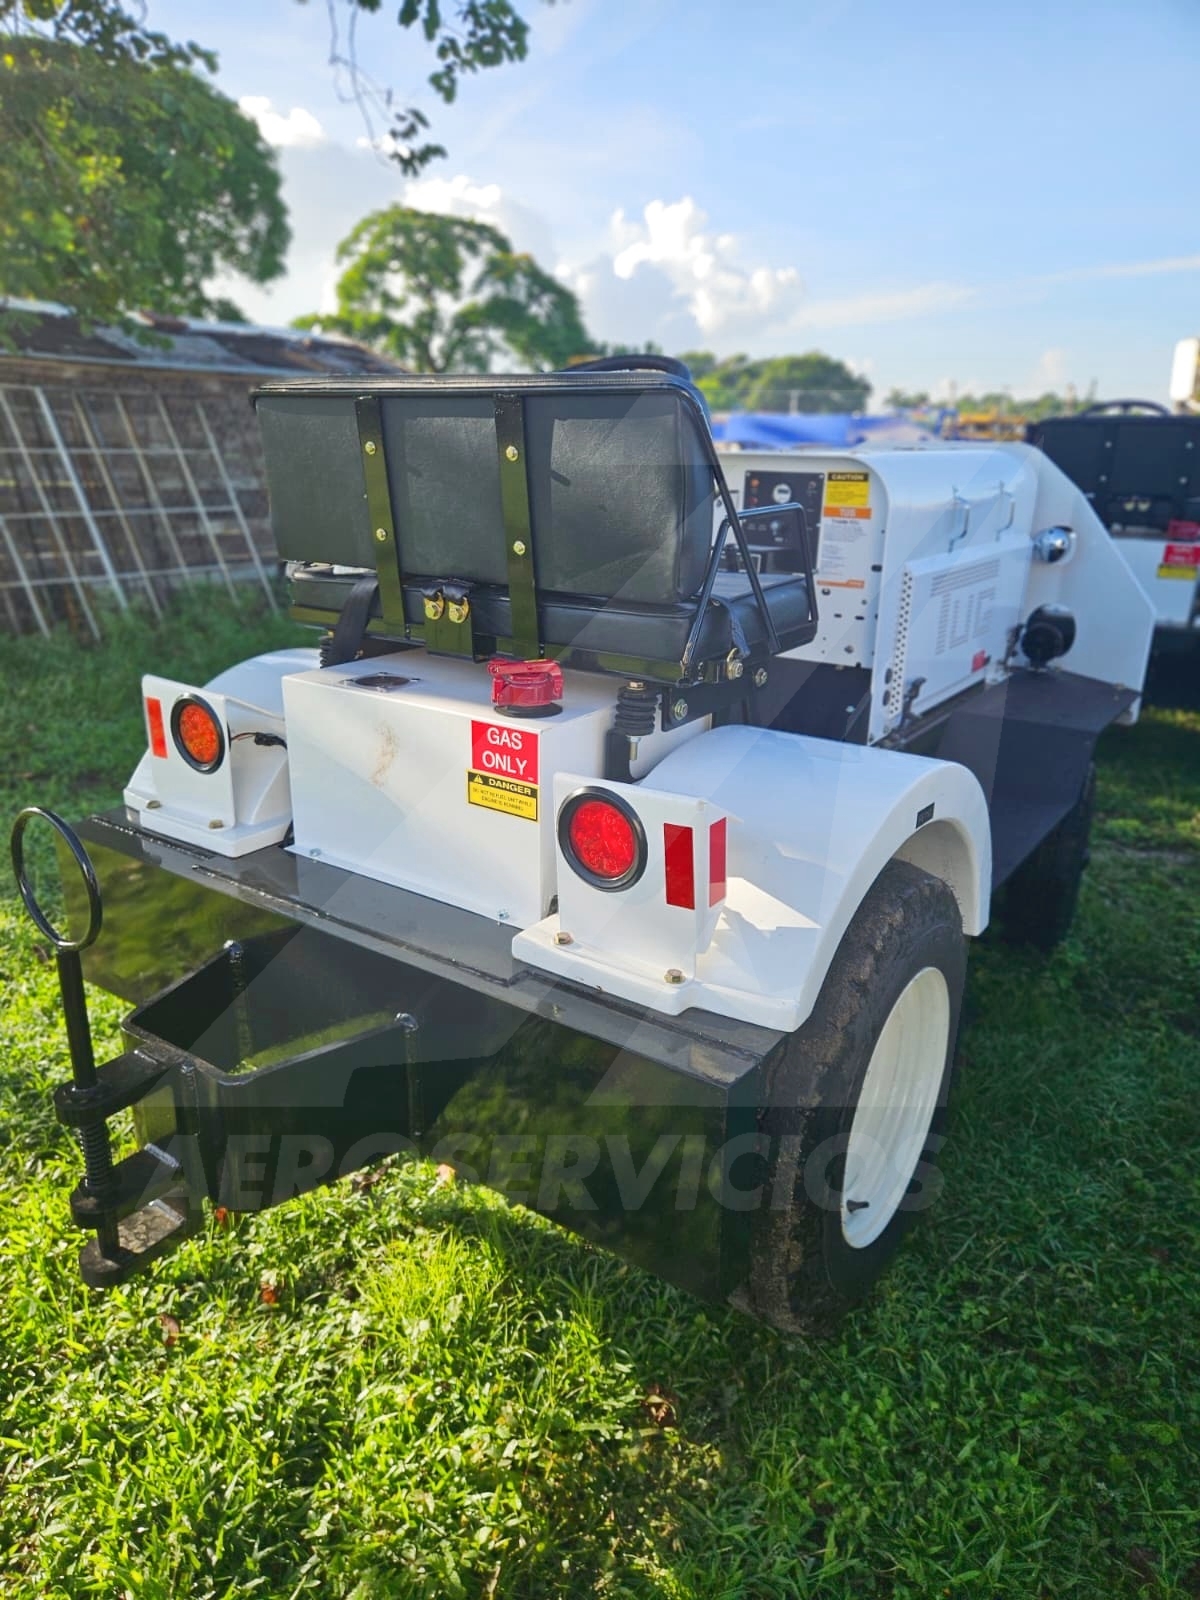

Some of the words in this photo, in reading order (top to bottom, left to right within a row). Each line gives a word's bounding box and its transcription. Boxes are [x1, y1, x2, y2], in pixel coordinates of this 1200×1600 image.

[831, 473, 865, 481] CAUTION
[487, 727, 523, 750] GAS
[482, 750, 527, 775] ONLY
[488, 778, 532, 796] DANGER
